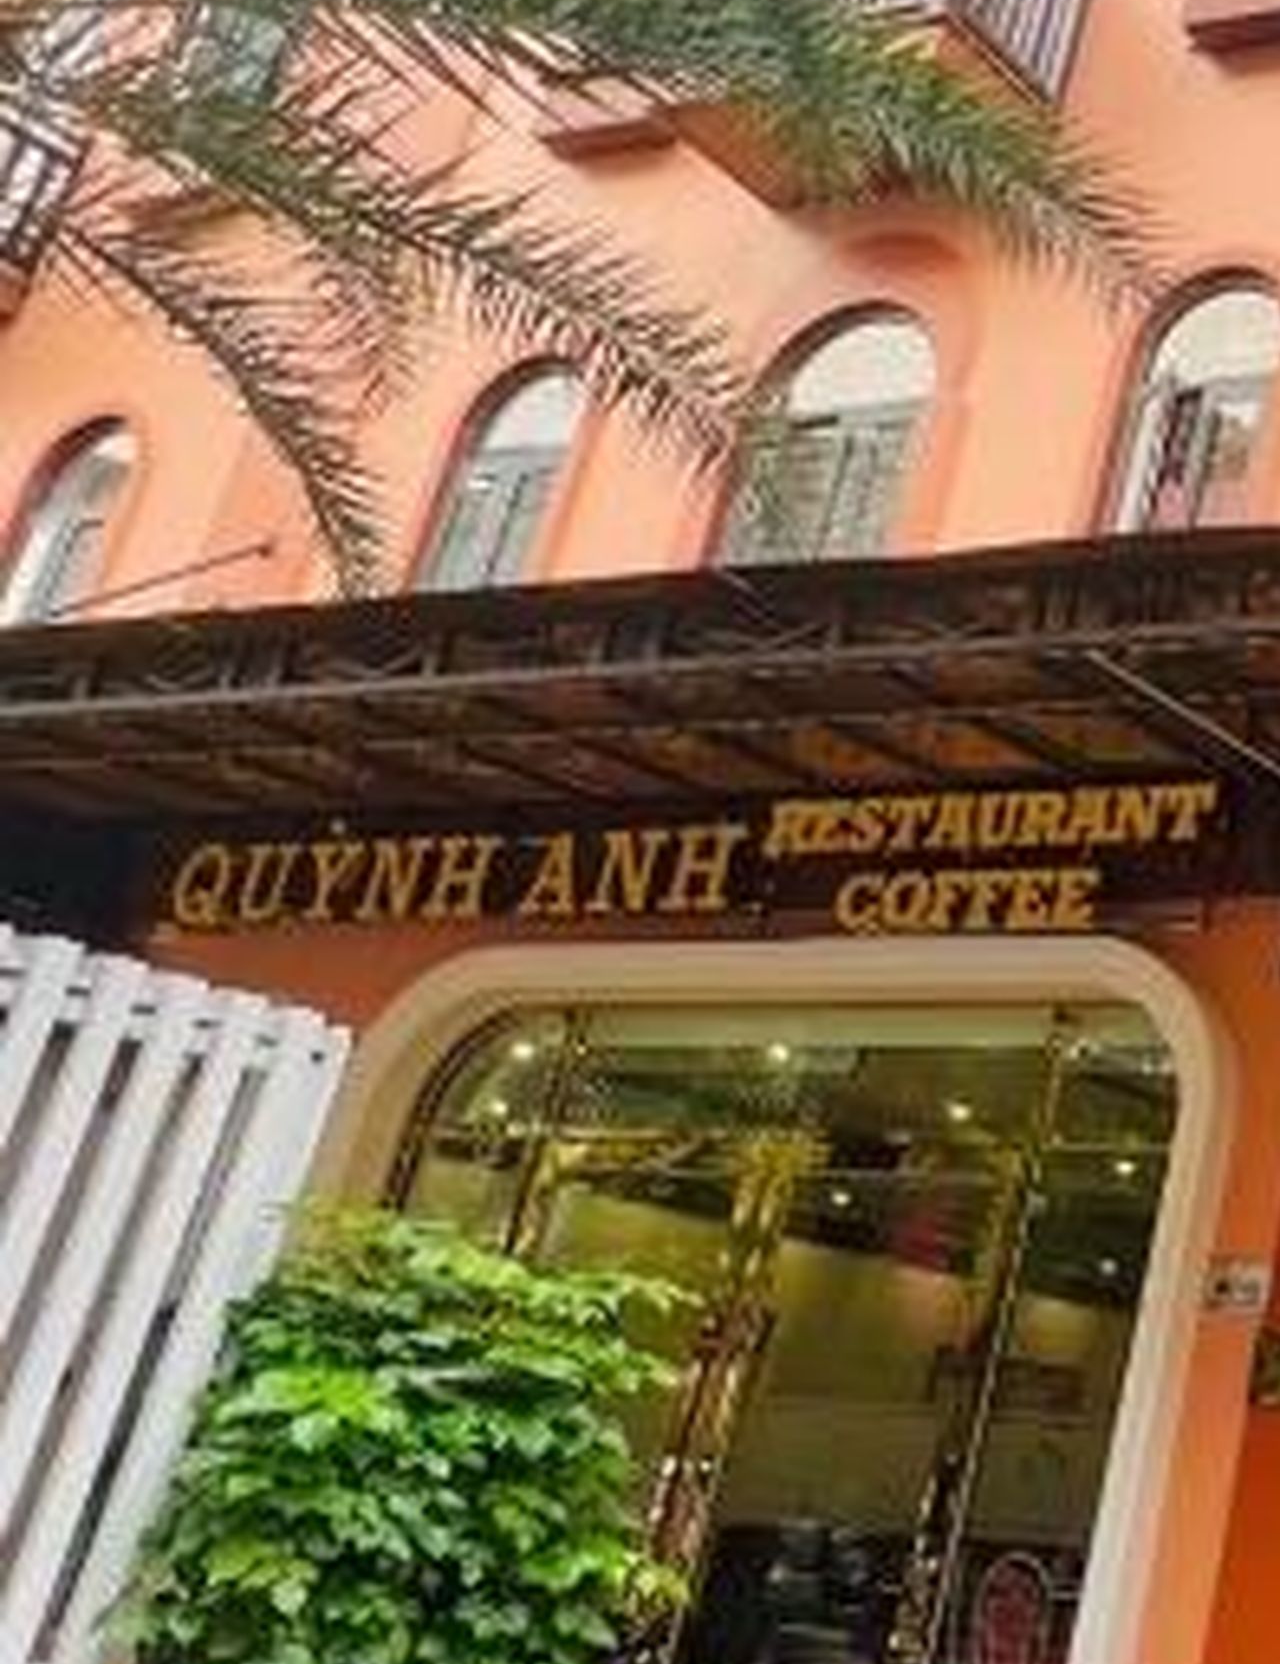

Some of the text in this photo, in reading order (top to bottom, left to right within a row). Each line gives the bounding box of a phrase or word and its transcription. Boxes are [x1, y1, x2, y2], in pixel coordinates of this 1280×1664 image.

[762, 781, 1217, 857] RESTAURANT
[517, 822, 749, 914] ANH
[834, 866, 1100, 934] COFFEE
